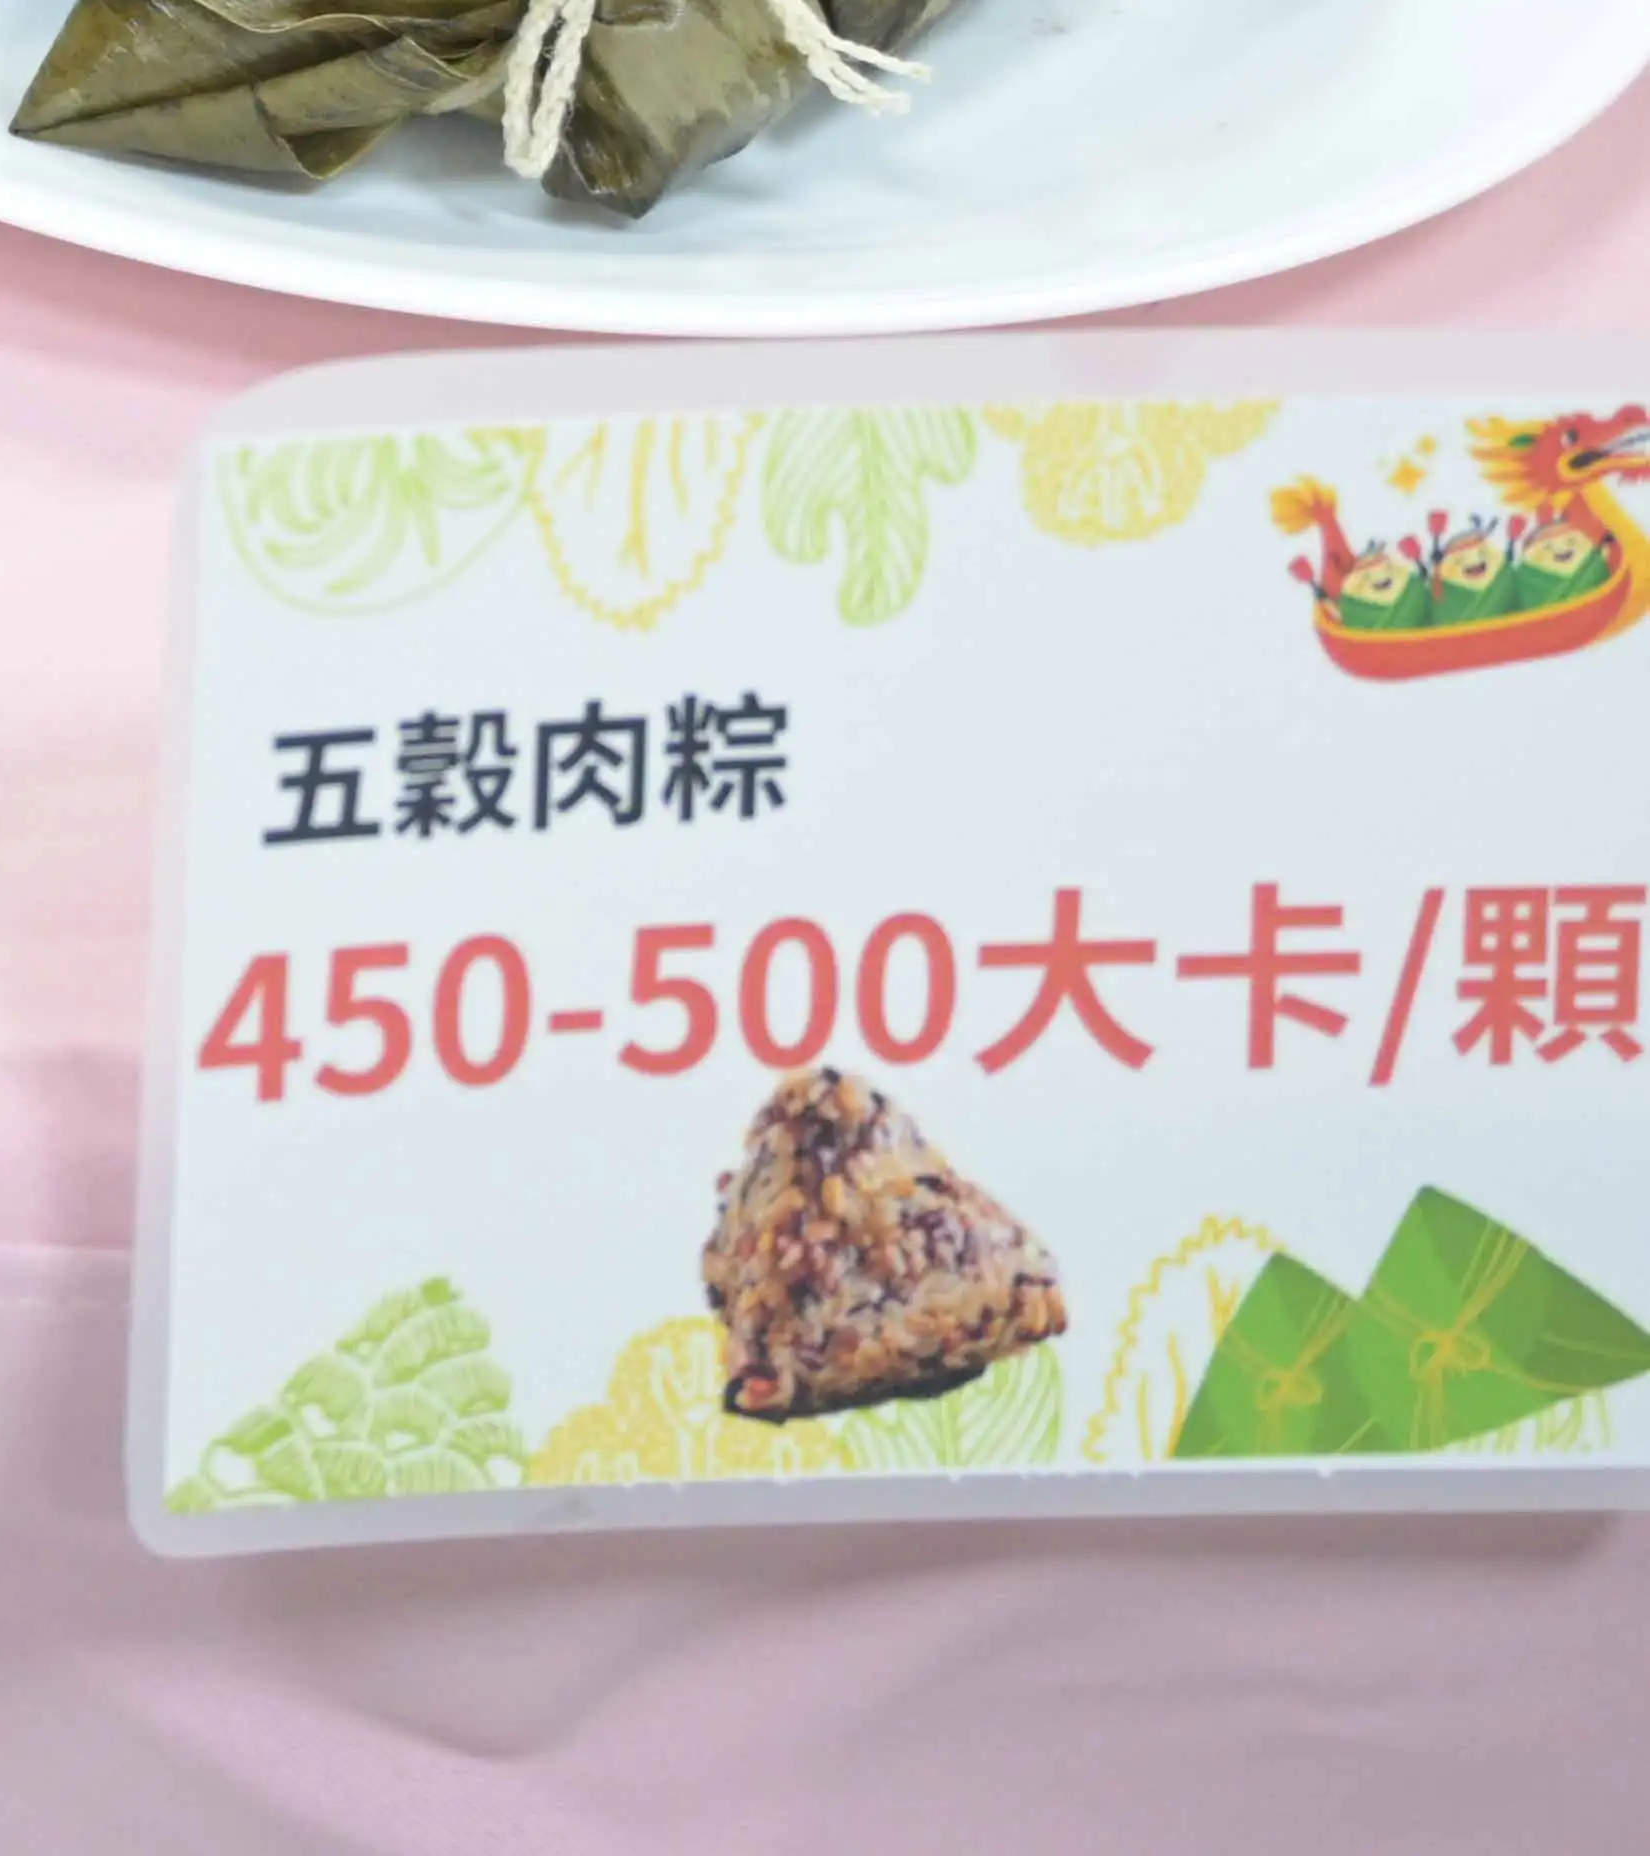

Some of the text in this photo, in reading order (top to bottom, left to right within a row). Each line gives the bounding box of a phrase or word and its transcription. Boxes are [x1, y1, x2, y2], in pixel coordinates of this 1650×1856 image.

[262, 691, 788, 845] 五穀肉粽
[197, 882, 1648, 1102] 450-500大卡/顆
